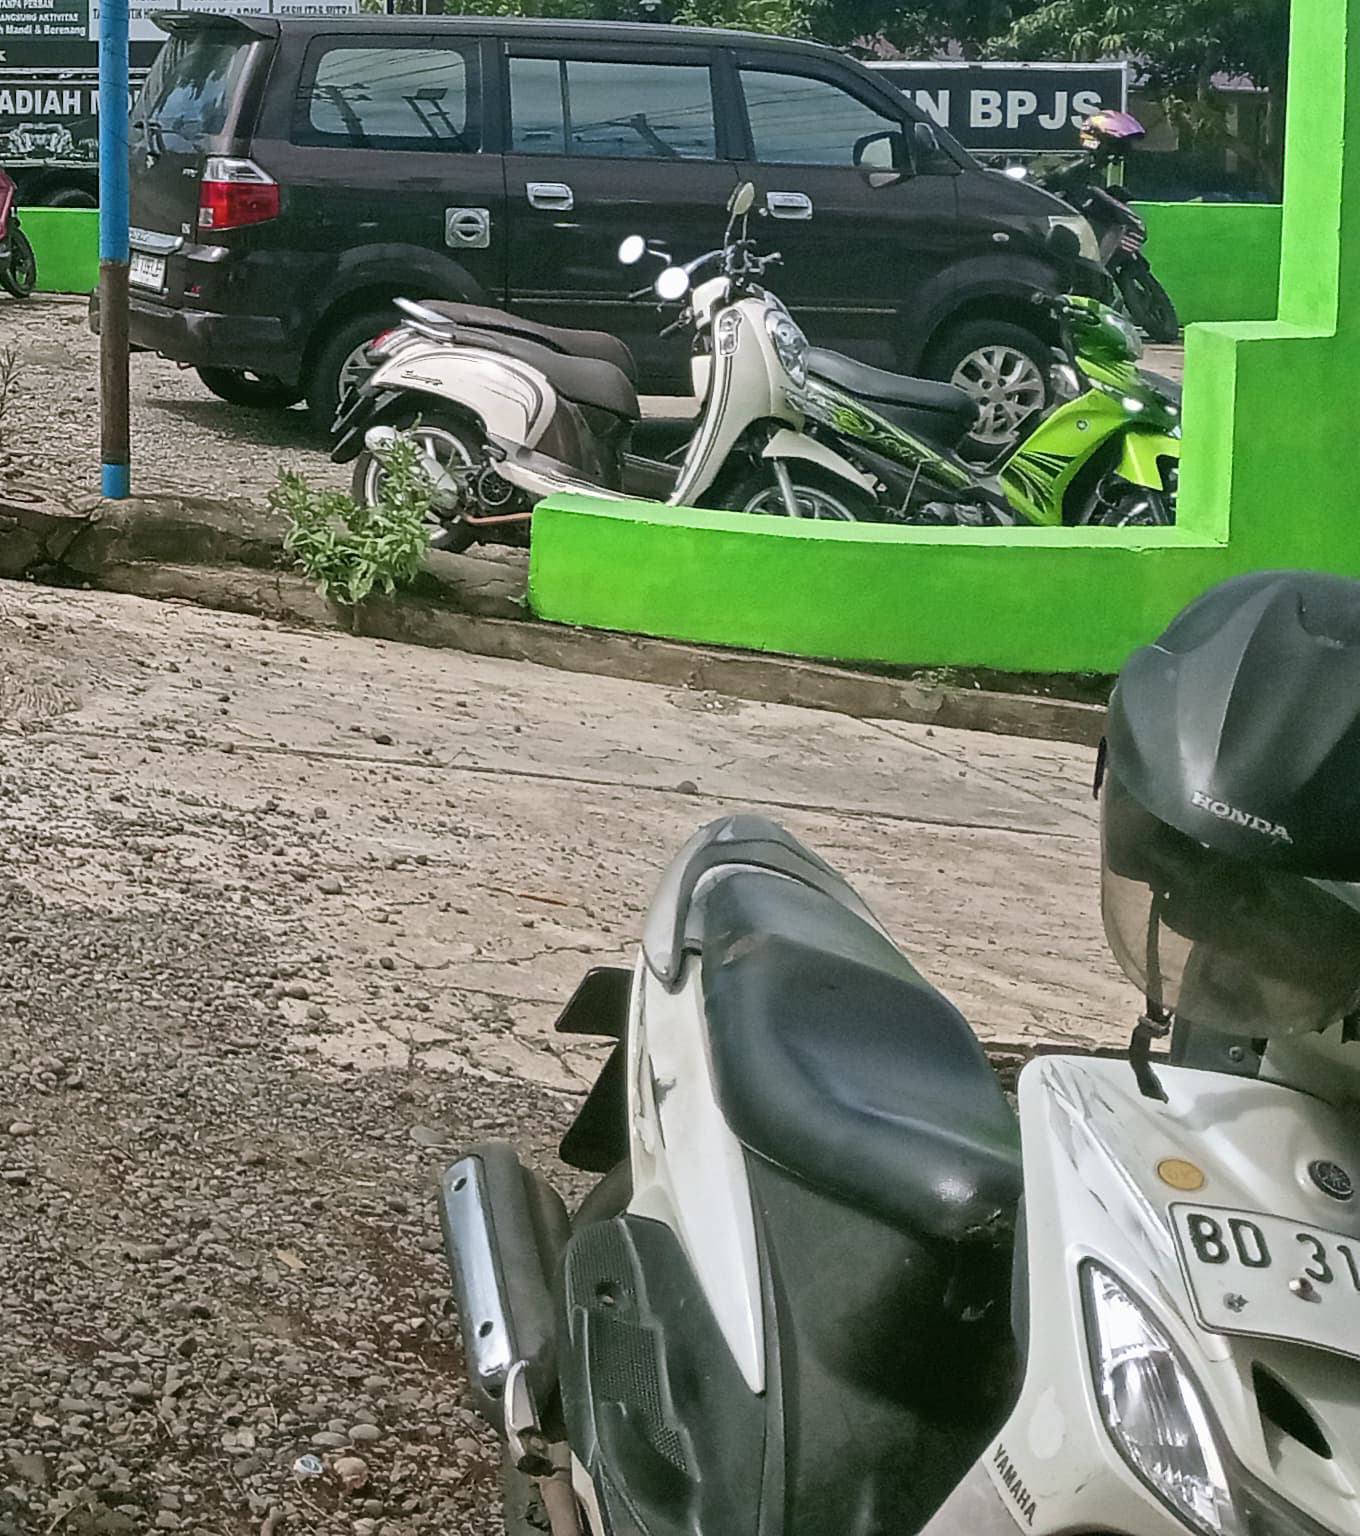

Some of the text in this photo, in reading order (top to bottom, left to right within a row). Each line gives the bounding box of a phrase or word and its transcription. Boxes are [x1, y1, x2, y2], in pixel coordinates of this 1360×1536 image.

[970, 90, 1102, 130] BPJS
[1191, 790, 1293, 845] HONDA
[1187, 1213, 1272, 1268] BD
[993, 1443, 1036, 1527] YAMAHA
